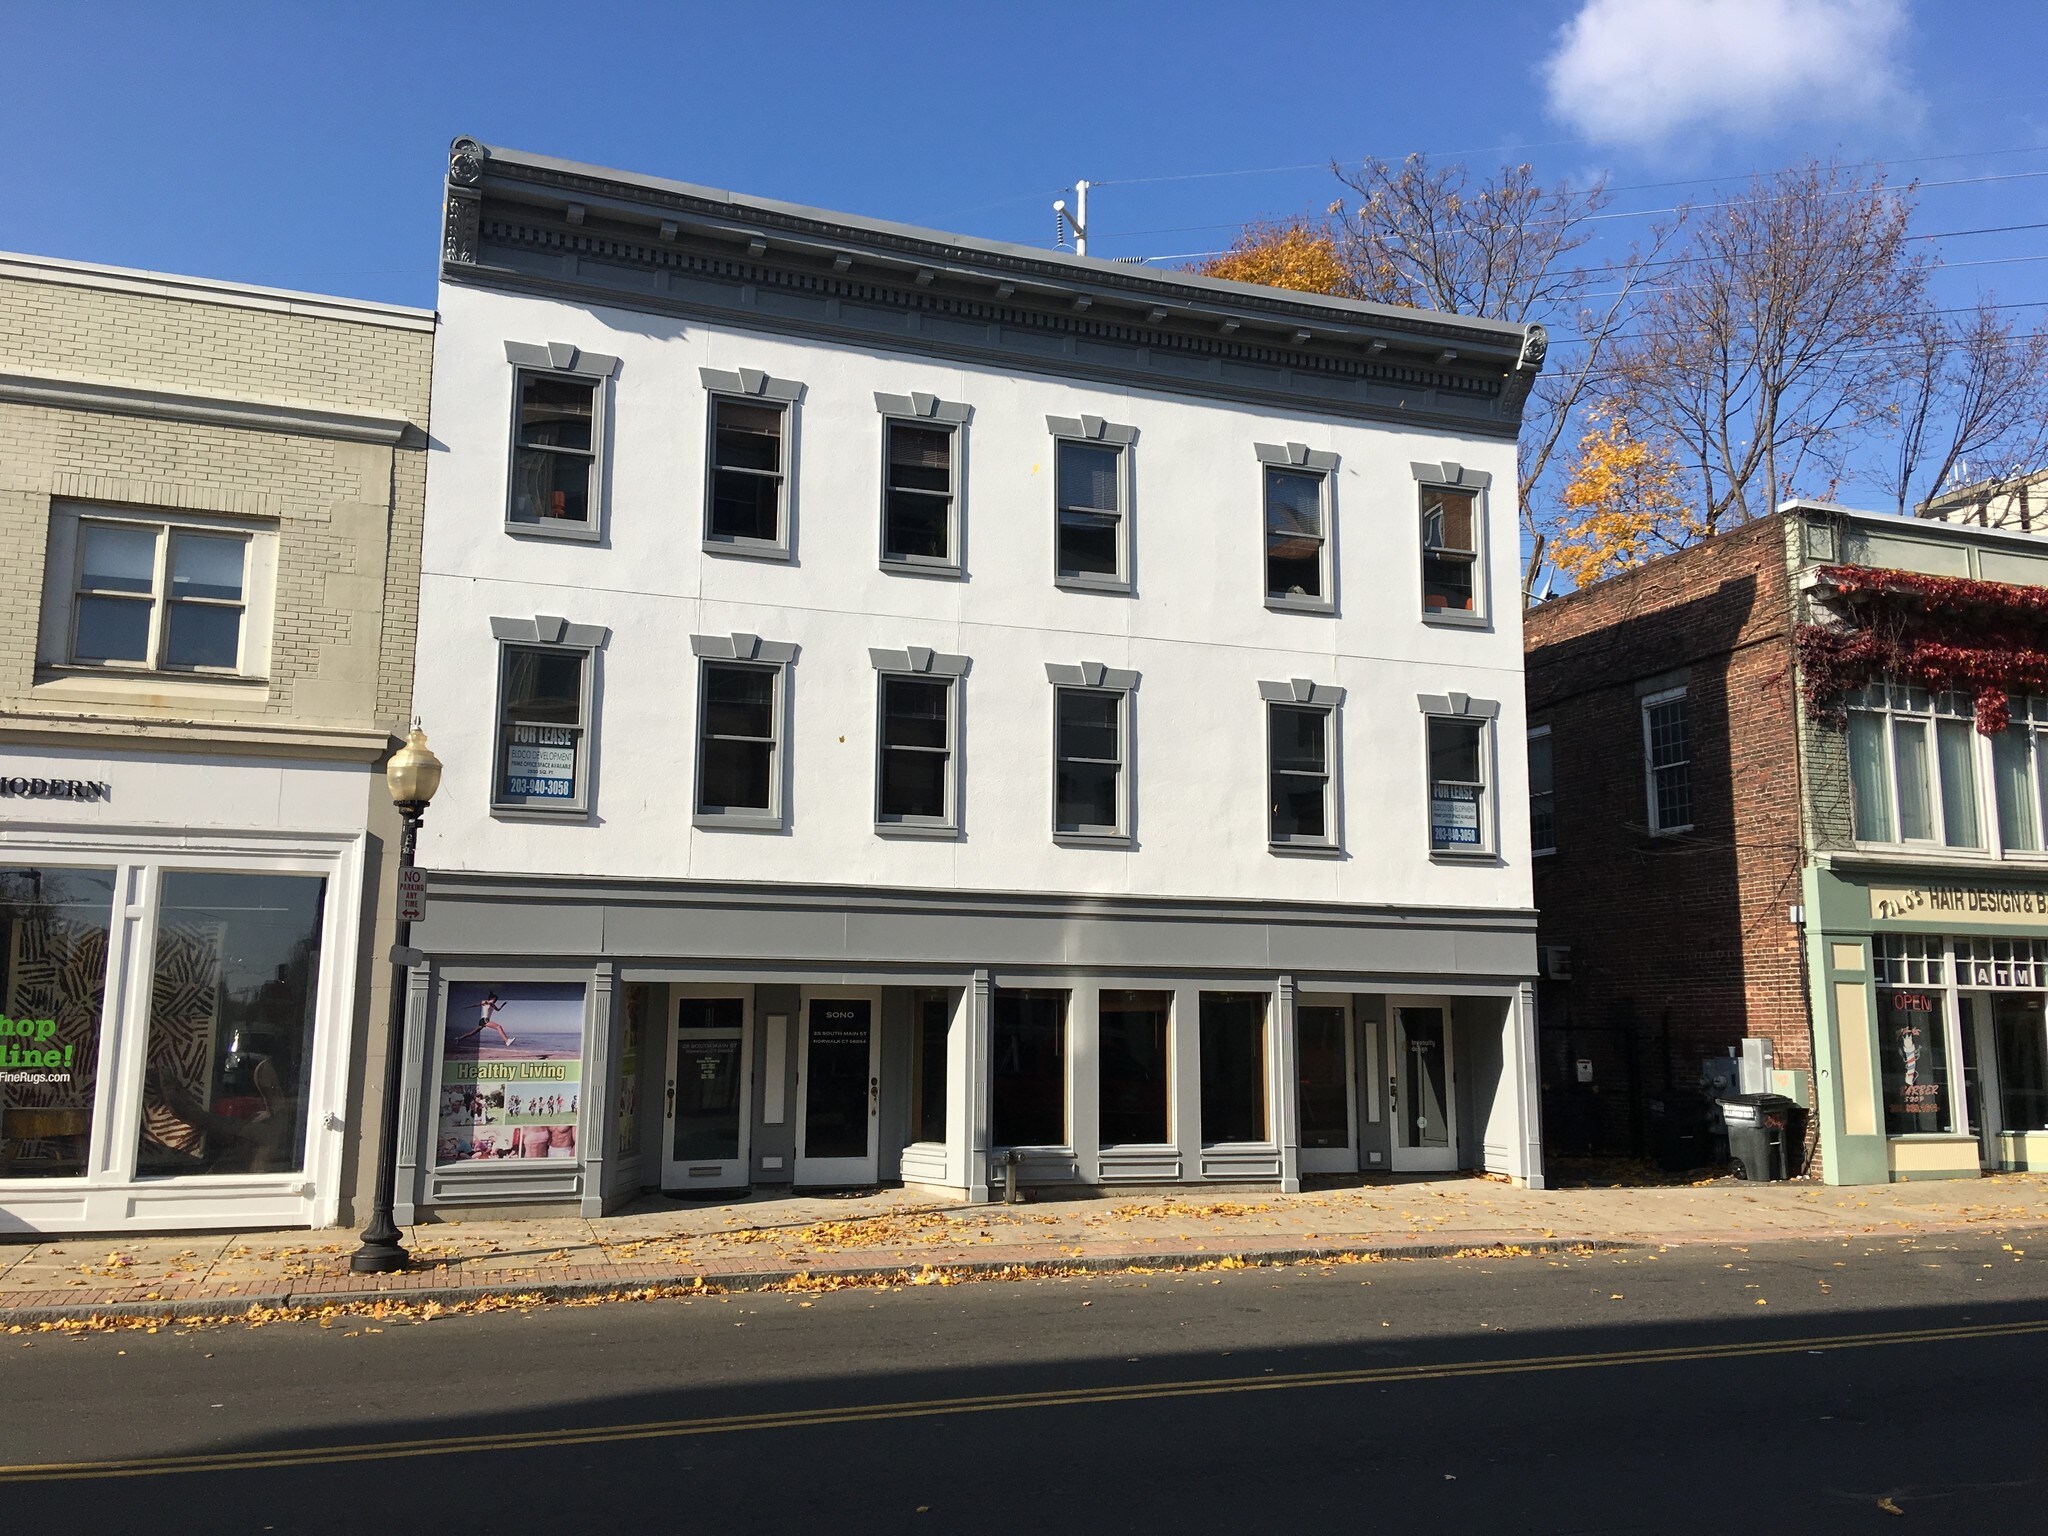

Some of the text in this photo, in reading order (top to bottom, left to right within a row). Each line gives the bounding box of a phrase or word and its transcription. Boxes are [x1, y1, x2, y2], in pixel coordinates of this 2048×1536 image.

[515, 727, 571, 745] FOR LEASE
[511, 778, 569, 796] 203-940-3058
[404, 871, 421, 883] NO
[400, 883, 425, 891] PARKING
[405, 900, 418, 908] TIME
[1928, 886, 1966, 910] HAIR
[1967, 887, 2022, 914] DESIGN
[2023, 890, 2033, 914] &
[2036, 890, 2048, 915] B
[1978, 968, 2029, 985] ATM
[1894, 993, 1931, 1011] OPEN
[825, 1011, 855, 1019] SONO
[458, 1062, 565, 1081] Healthy Living
